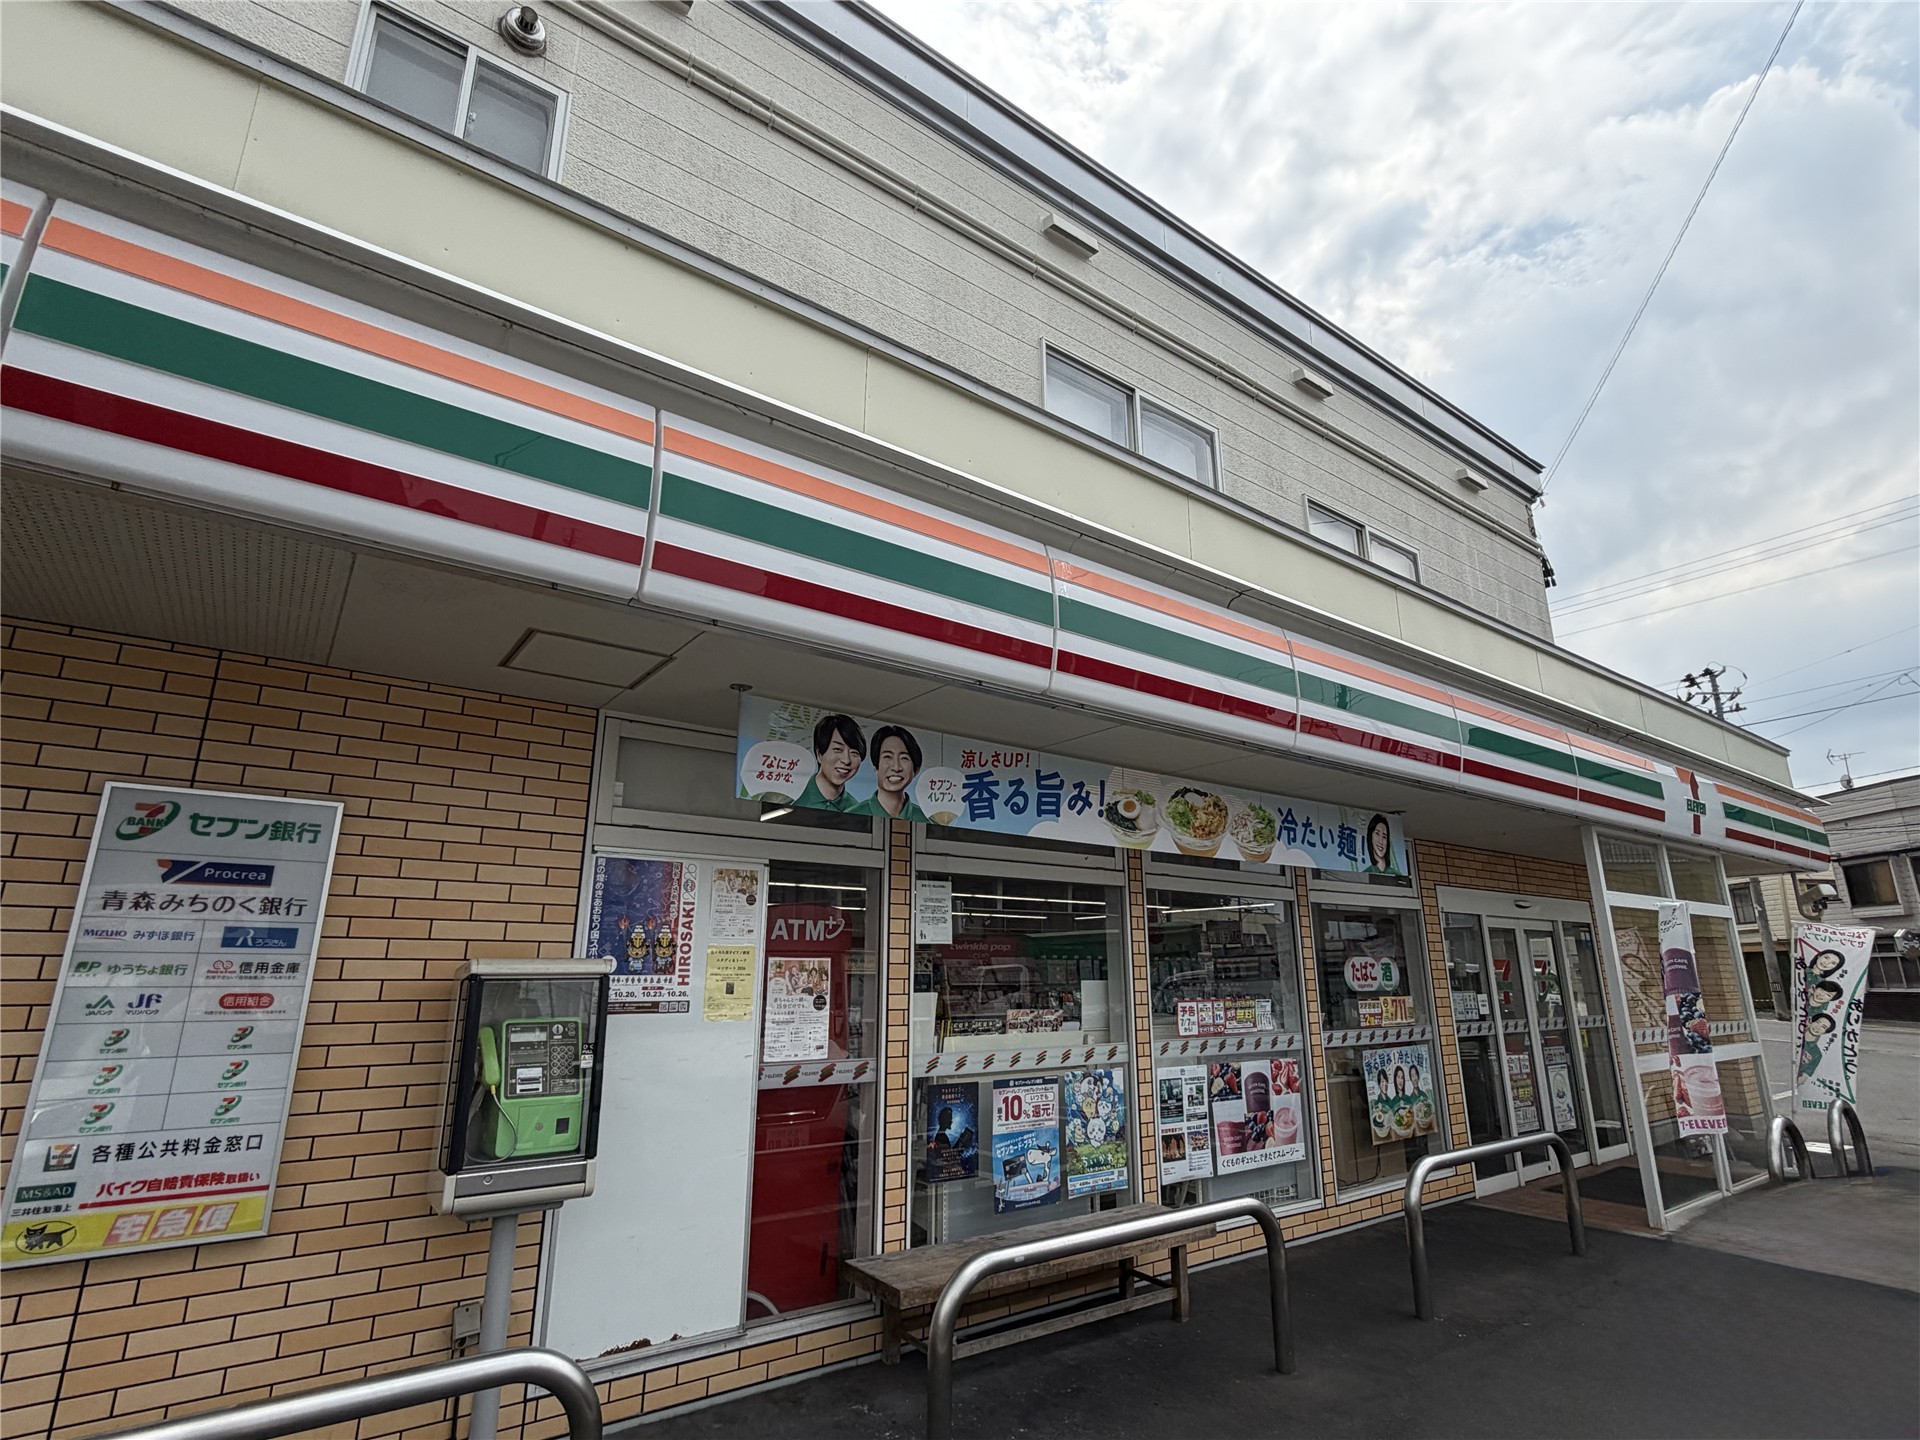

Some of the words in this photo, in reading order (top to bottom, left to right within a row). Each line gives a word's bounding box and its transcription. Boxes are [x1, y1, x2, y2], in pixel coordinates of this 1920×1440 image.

[960, 749, 1031, 769] 涼しさUP!
[960, 769, 1106, 823] 香る旨み!
[126, 816, 165, 828] BANK
[188, 812, 322, 845] セブン銀行
[1276, 806, 1367, 865] 冷たい麺!
[203, 867, 268, 882] Procrea
[101, 889, 309, 917] 青森みちのく銀行
[82, 928, 128, 938] MIZUHO
[132, 930, 196, 941] みずほ銀行
[770, 919, 826, 942] ATM
[676, 900, 696, 987] HIROSAKI
[989, 943, 1011, 952] pop
[107, 963, 189, 977] ゆうちょ銀行
[239, 961, 301, 975] 信用金庫
[1350, 961, 1378, 983] たばこ
[1380, 962, 1393, 982] 酒
[222, 995, 272, 1008] 信用組合
[85, 1009, 114, 1017] JAバンク
[1179, 1005, 1196, 1018] 予告
[91, 1133, 264, 1165] 各種公共料金窓口
[21, 1184, 72, 1200] MS&AD
[96, 1171, 261, 1198] バイク自賠責保険取扱い
[10, 1203, 73, 1218] 三井住友海上
[104, 1201, 238, 1244] 宅急便
